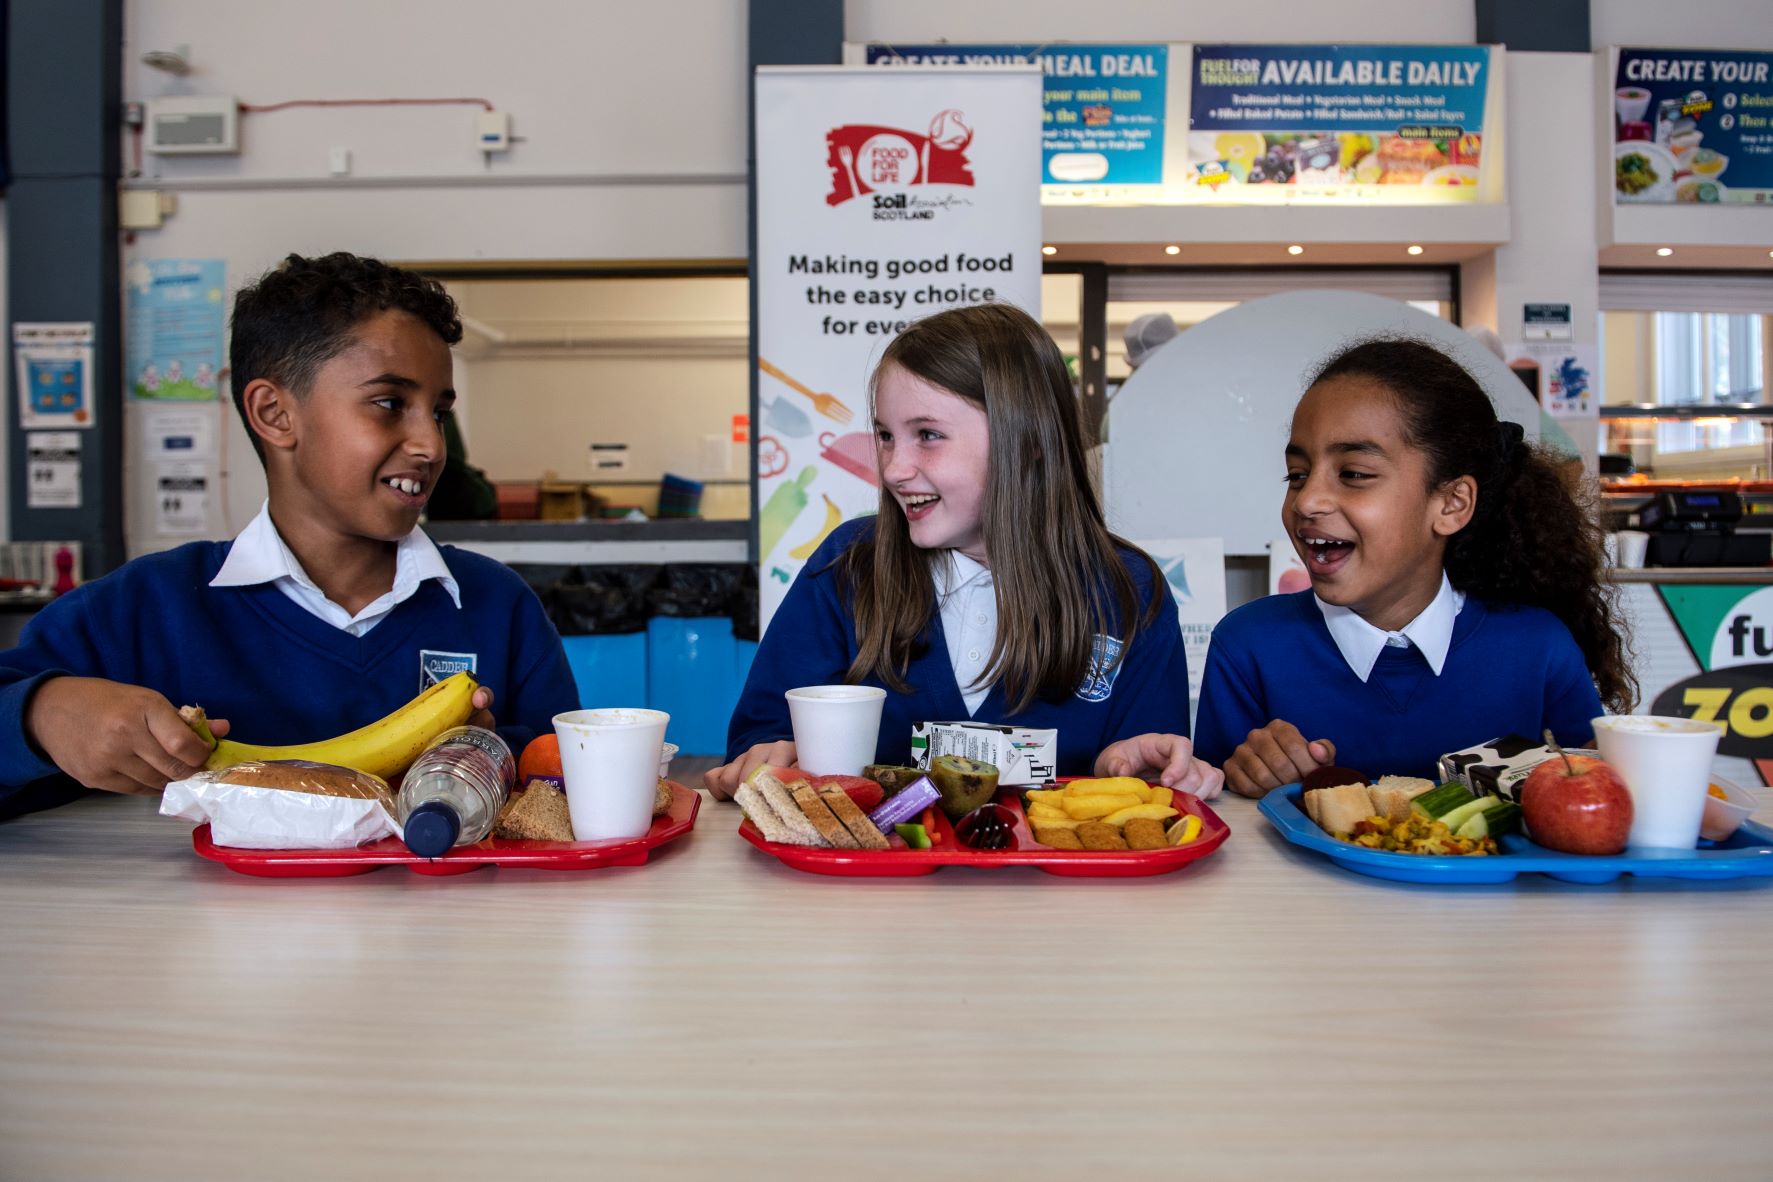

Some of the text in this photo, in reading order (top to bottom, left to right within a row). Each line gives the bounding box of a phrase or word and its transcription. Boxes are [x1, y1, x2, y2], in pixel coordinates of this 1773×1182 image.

[1036, 55, 1096, 77] MEAL
[1101, 55, 1158, 77] DEAL
[1262, 59, 1481, 87] AVAILABLE DAILY
[1626, 59, 1769, 83] CREATE YOUR
[1044, 87, 1142, 105] your main item
[872, 148, 909, 159] FOOD
[872, 159, 899, 170] FOR
[872, 172, 899, 183] LIFE
[873, 210, 935, 220] SCOTLAND
[788, 253, 1013, 280] Making good food
[807, 284, 996, 309] the easy choice
[823, 316, 909, 335] for eve
